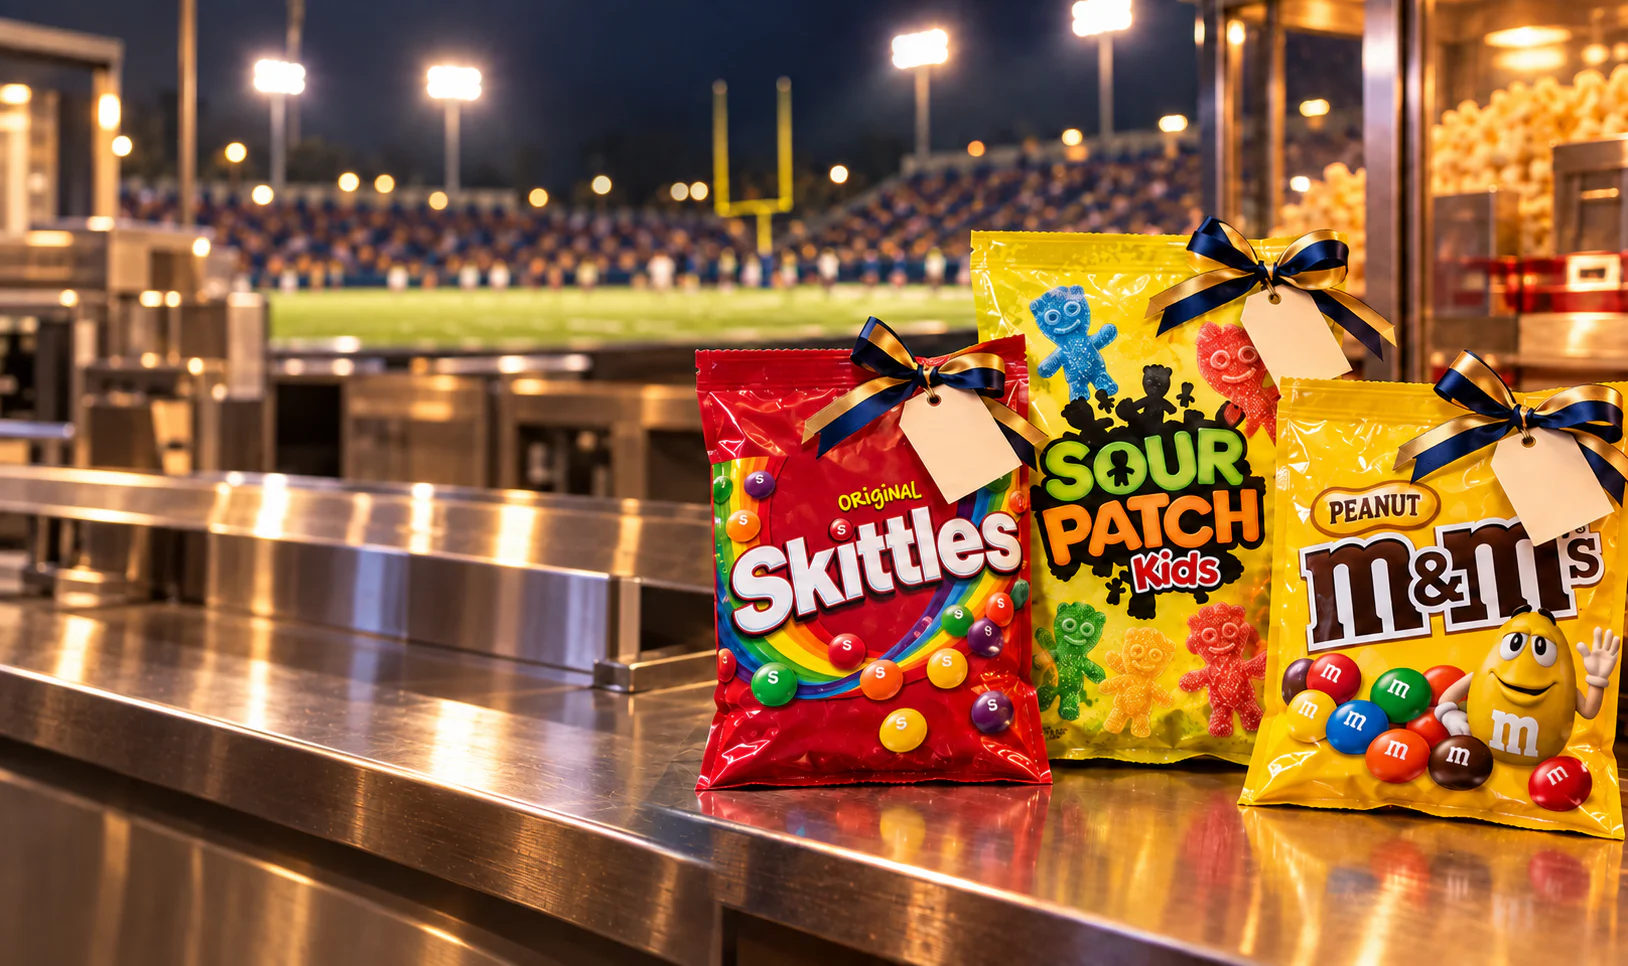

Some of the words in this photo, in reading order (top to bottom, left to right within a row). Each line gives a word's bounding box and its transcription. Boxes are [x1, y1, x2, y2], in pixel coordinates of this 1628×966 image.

[1045, 427, 1244, 502] SOUR
[755, 474, 765, 484] S
[1329, 493, 1421, 525] PEANUT
[738, 514, 748, 525] S
[1042, 488, 1260, 566] PATCH
[731, 505, 1022, 634] Skittles
[1132, 550, 1219, 592] Kids
[997, 597, 1005, 609] S
[842, 639, 852, 651] S
[942, 655, 953, 667] S
[767, 670, 779, 684] S
[875, 666, 886, 679] S
[987, 698, 998, 711] S
[895, 716, 907, 729] S
